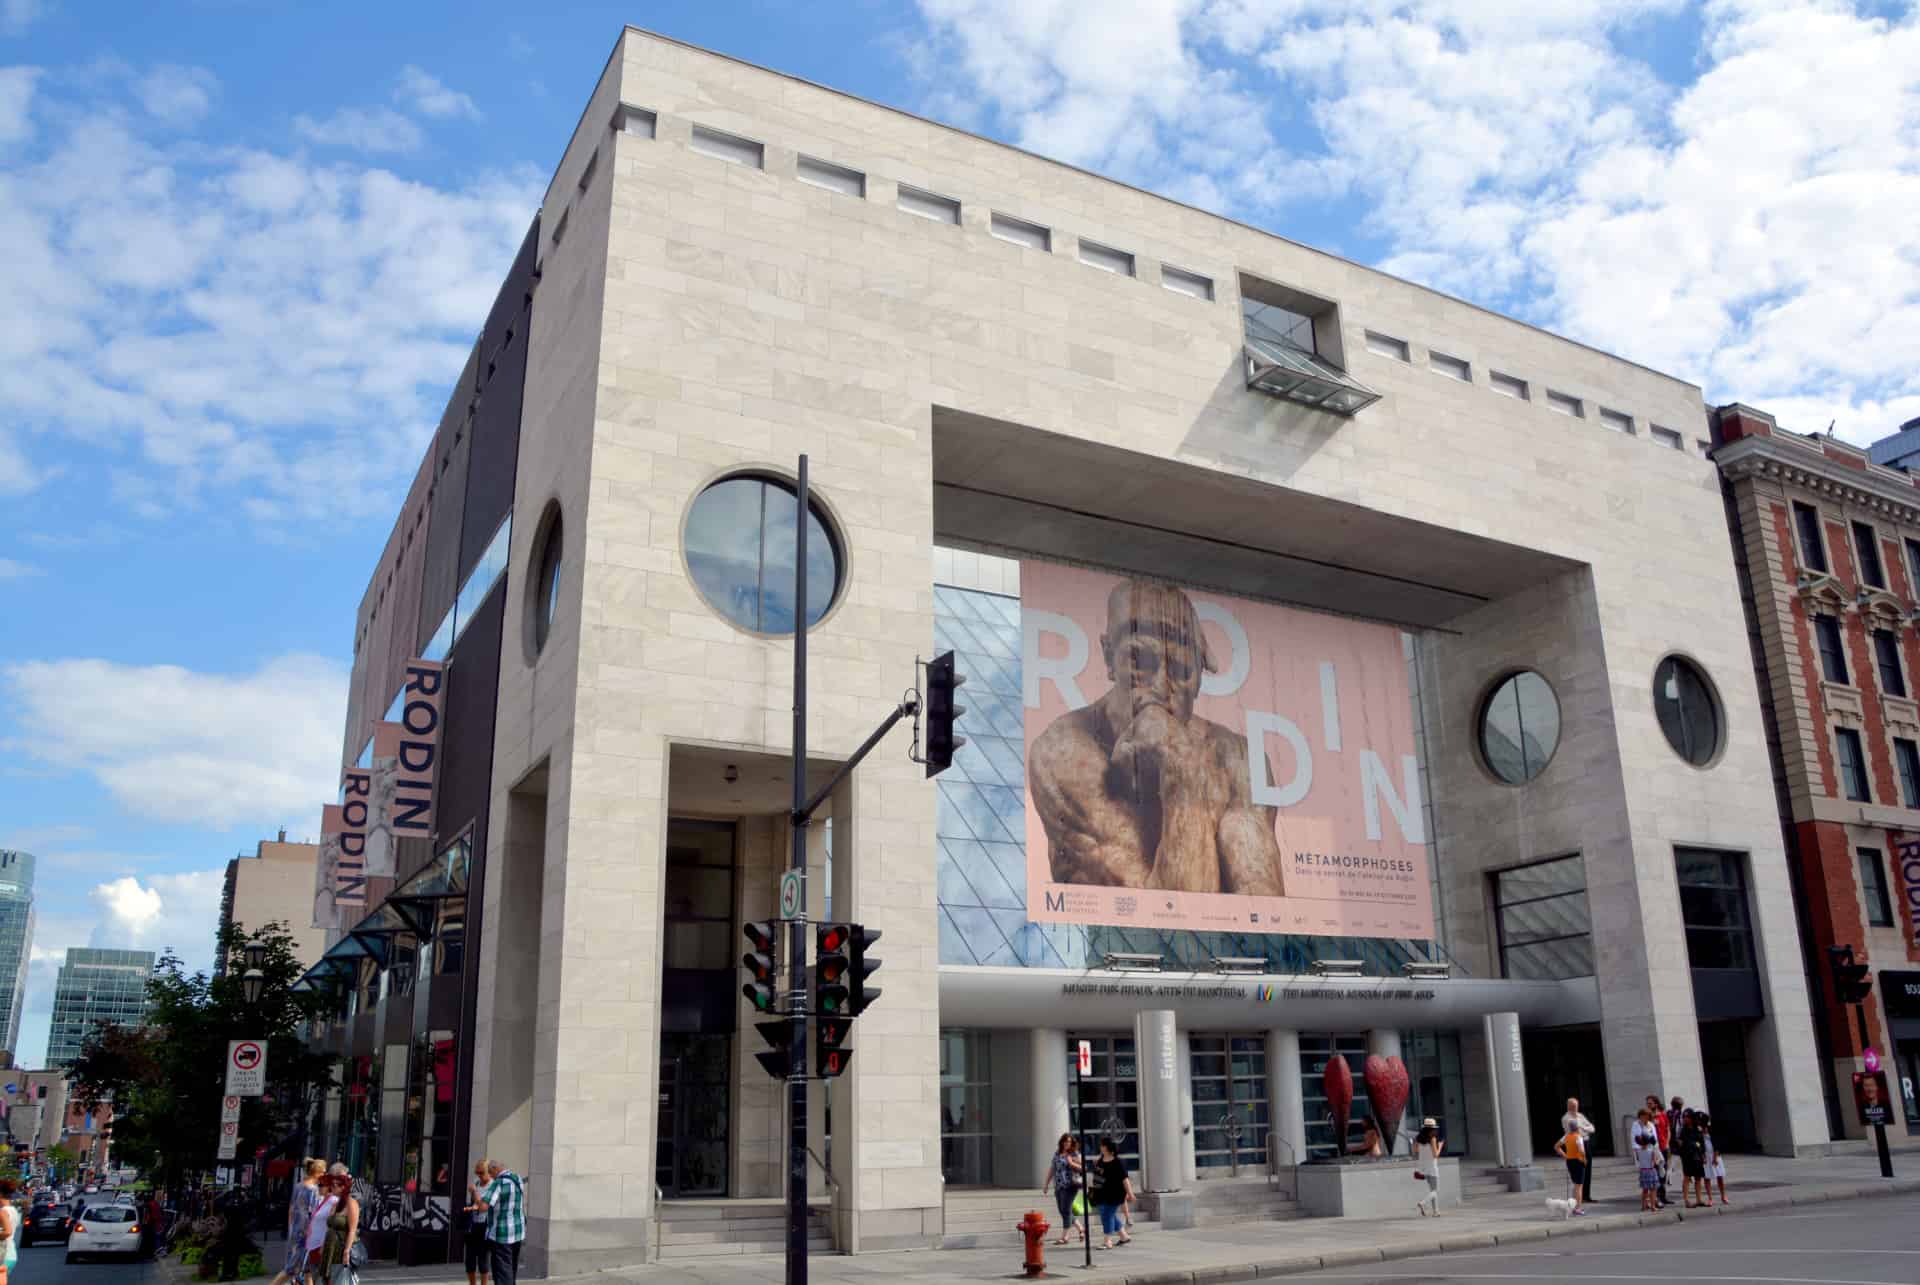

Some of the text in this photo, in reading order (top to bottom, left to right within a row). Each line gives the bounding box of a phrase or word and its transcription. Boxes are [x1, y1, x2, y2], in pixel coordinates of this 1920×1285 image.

[393, 666, 442, 831] RODIN
[336, 773, 370, 900] RODIN
[1045, 890, 1065, 912] M
